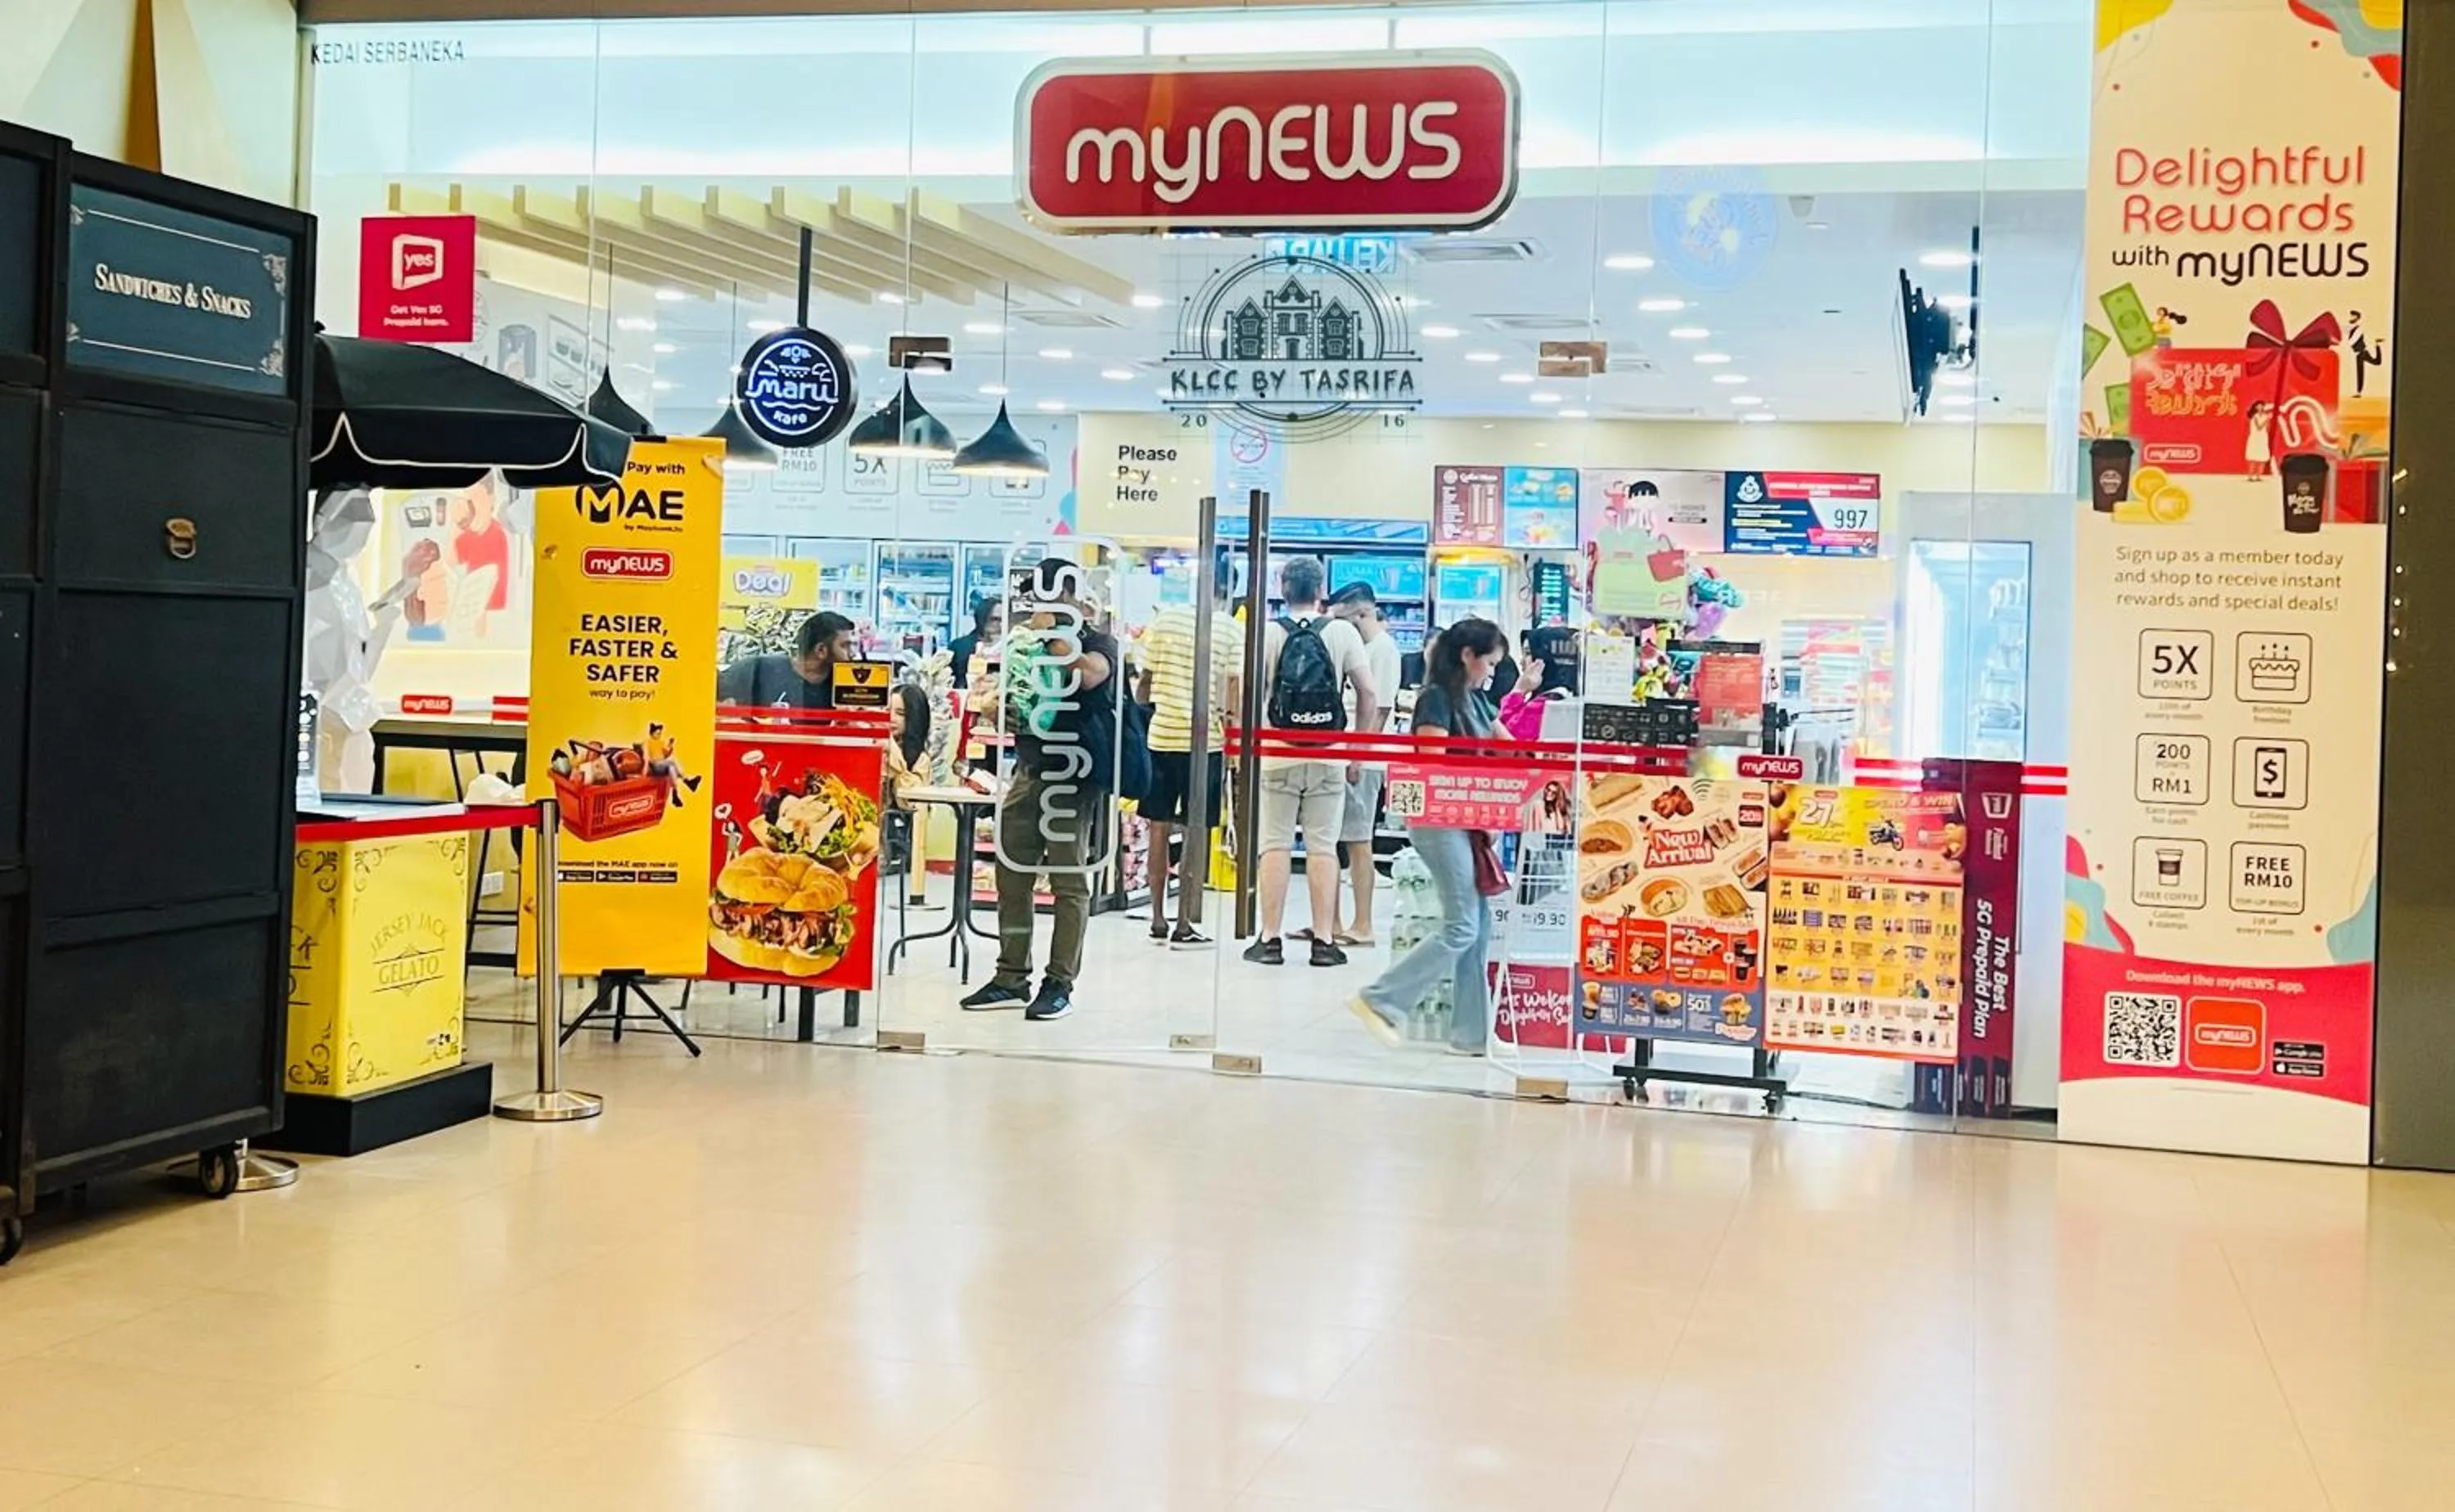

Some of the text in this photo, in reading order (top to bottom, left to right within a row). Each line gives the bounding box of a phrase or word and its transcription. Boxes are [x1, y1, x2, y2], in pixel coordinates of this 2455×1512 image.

[310, 40, 466, 65] KEDAI SERBANEKA
[1066, 101, 1462, 203] myNEWS
[2115, 146, 2365, 196] Delightful
[2123, 193, 2355, 233] Rewards
[403, 250, 435, 270] yes
[2112, 242, 2370, 286] with myNEWS
[94, 263, 251, 319] SANDWICHES & SNACKS
[746, 378, 838, 403] maru
[1171, 368, 1415, 398] KLCC BY TASRIFA
[1182, 415, 1207, 427] 20
[1384, 415, 1405, 427] 16
[1118, 445, 1178, 461] Please
[628, 461, 685, 475] Pay with
[1116, 485, 1158, 502] Here
[1834, 510, 1868, 529] 997
[590, 556, 664, 574] myNEWS
[2115, 547, 2344, 569] Sign up as a member today
[2115, 570, 2341, 588] and shop to receive instant
[2116, 593, 2339, 611] rewards and special deals!
[581, 615, 667, 636] EASIER,
[570, 639, 678, 658] FASTER &
[2152, 646, 2198, 675] 5X
[587, 664, 660, 682] SAFER
[589, 690, 612, 699] way
[2153, 680, 2197, 690] POINTS
[1291, 711, 1333, 723] adidas
[2157, 744, 2191, 759] 200
[2152, 778, 2191, 794] RM1
[1655, 831, 1700, 848] New
[1648, 844, 1712, 863] Arrival
[2246, 857, 2291, 871] FREE
[2245, 874, 2292, 889] RM10
[371, 911, 448, 956] JERSEY JACK
[379, 955, 439, 984] GELATO
[1973, 925, 1990, 997] Prepaid
[1993, 937, 2010, 1010] The Best
[2126, 970, 2305, 992] Download the myNEWS app.
[1972, 1000, 1987, 1038] Plan
